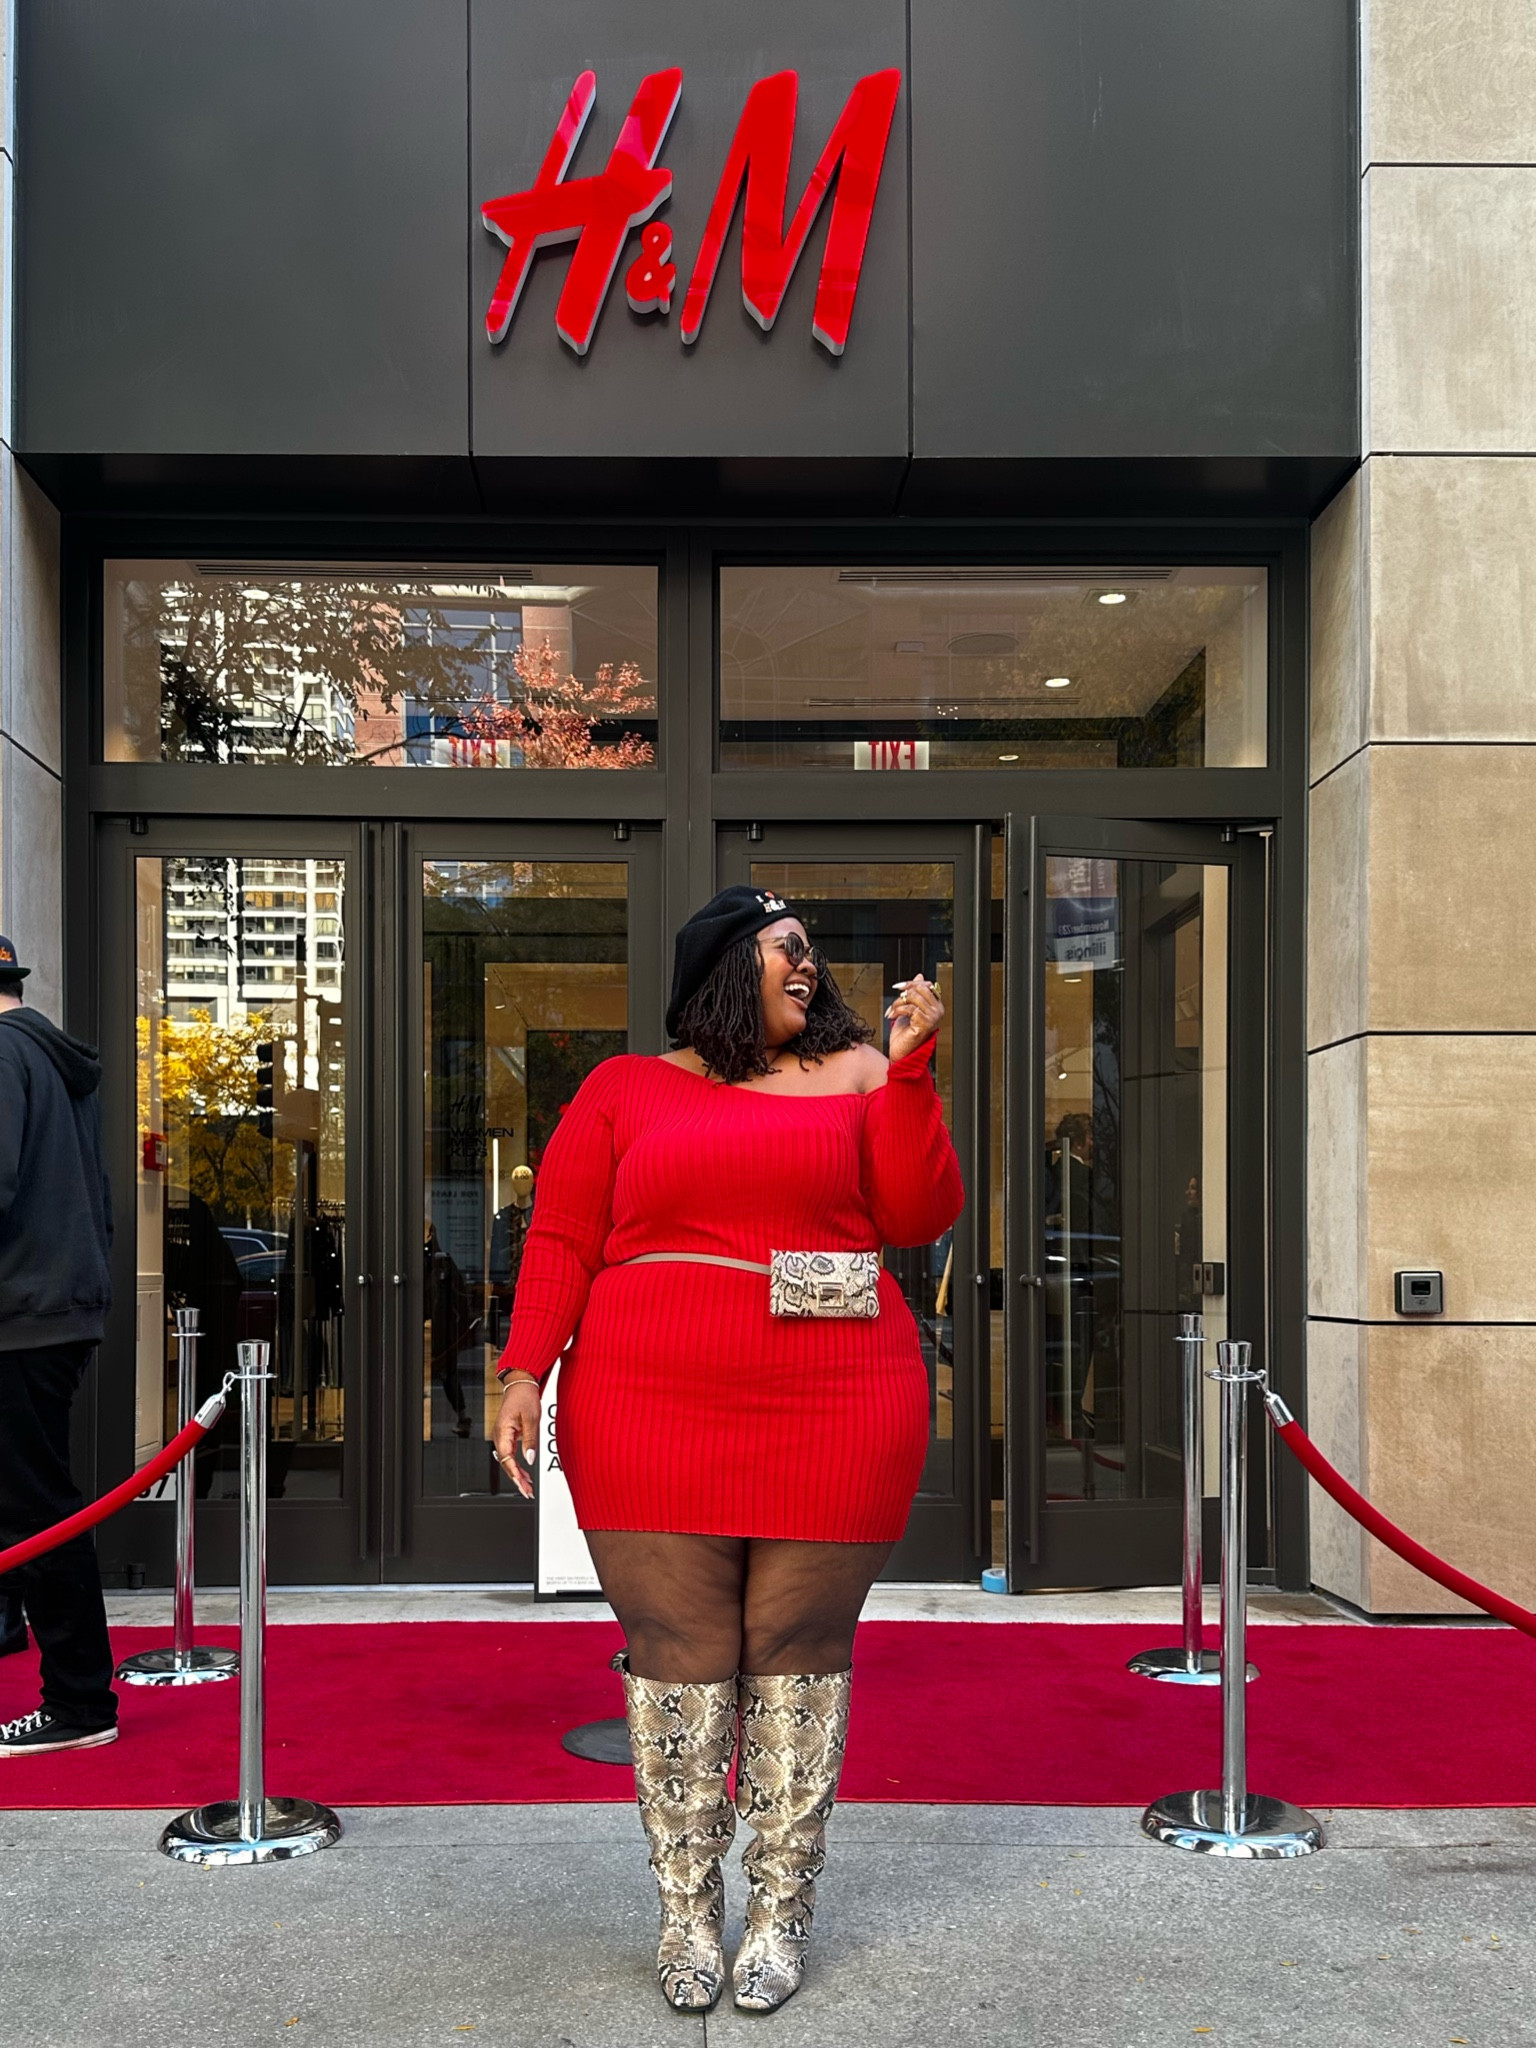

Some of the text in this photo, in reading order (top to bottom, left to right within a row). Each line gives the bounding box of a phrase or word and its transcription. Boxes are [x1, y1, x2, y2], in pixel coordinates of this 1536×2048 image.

[481, 67, 901, 356] H&M
[450, 1128, 514, 1138] WOMEN
[450, 1137, 487, 1147] MEN
[450, 1147, 488, 1157] KIDS
